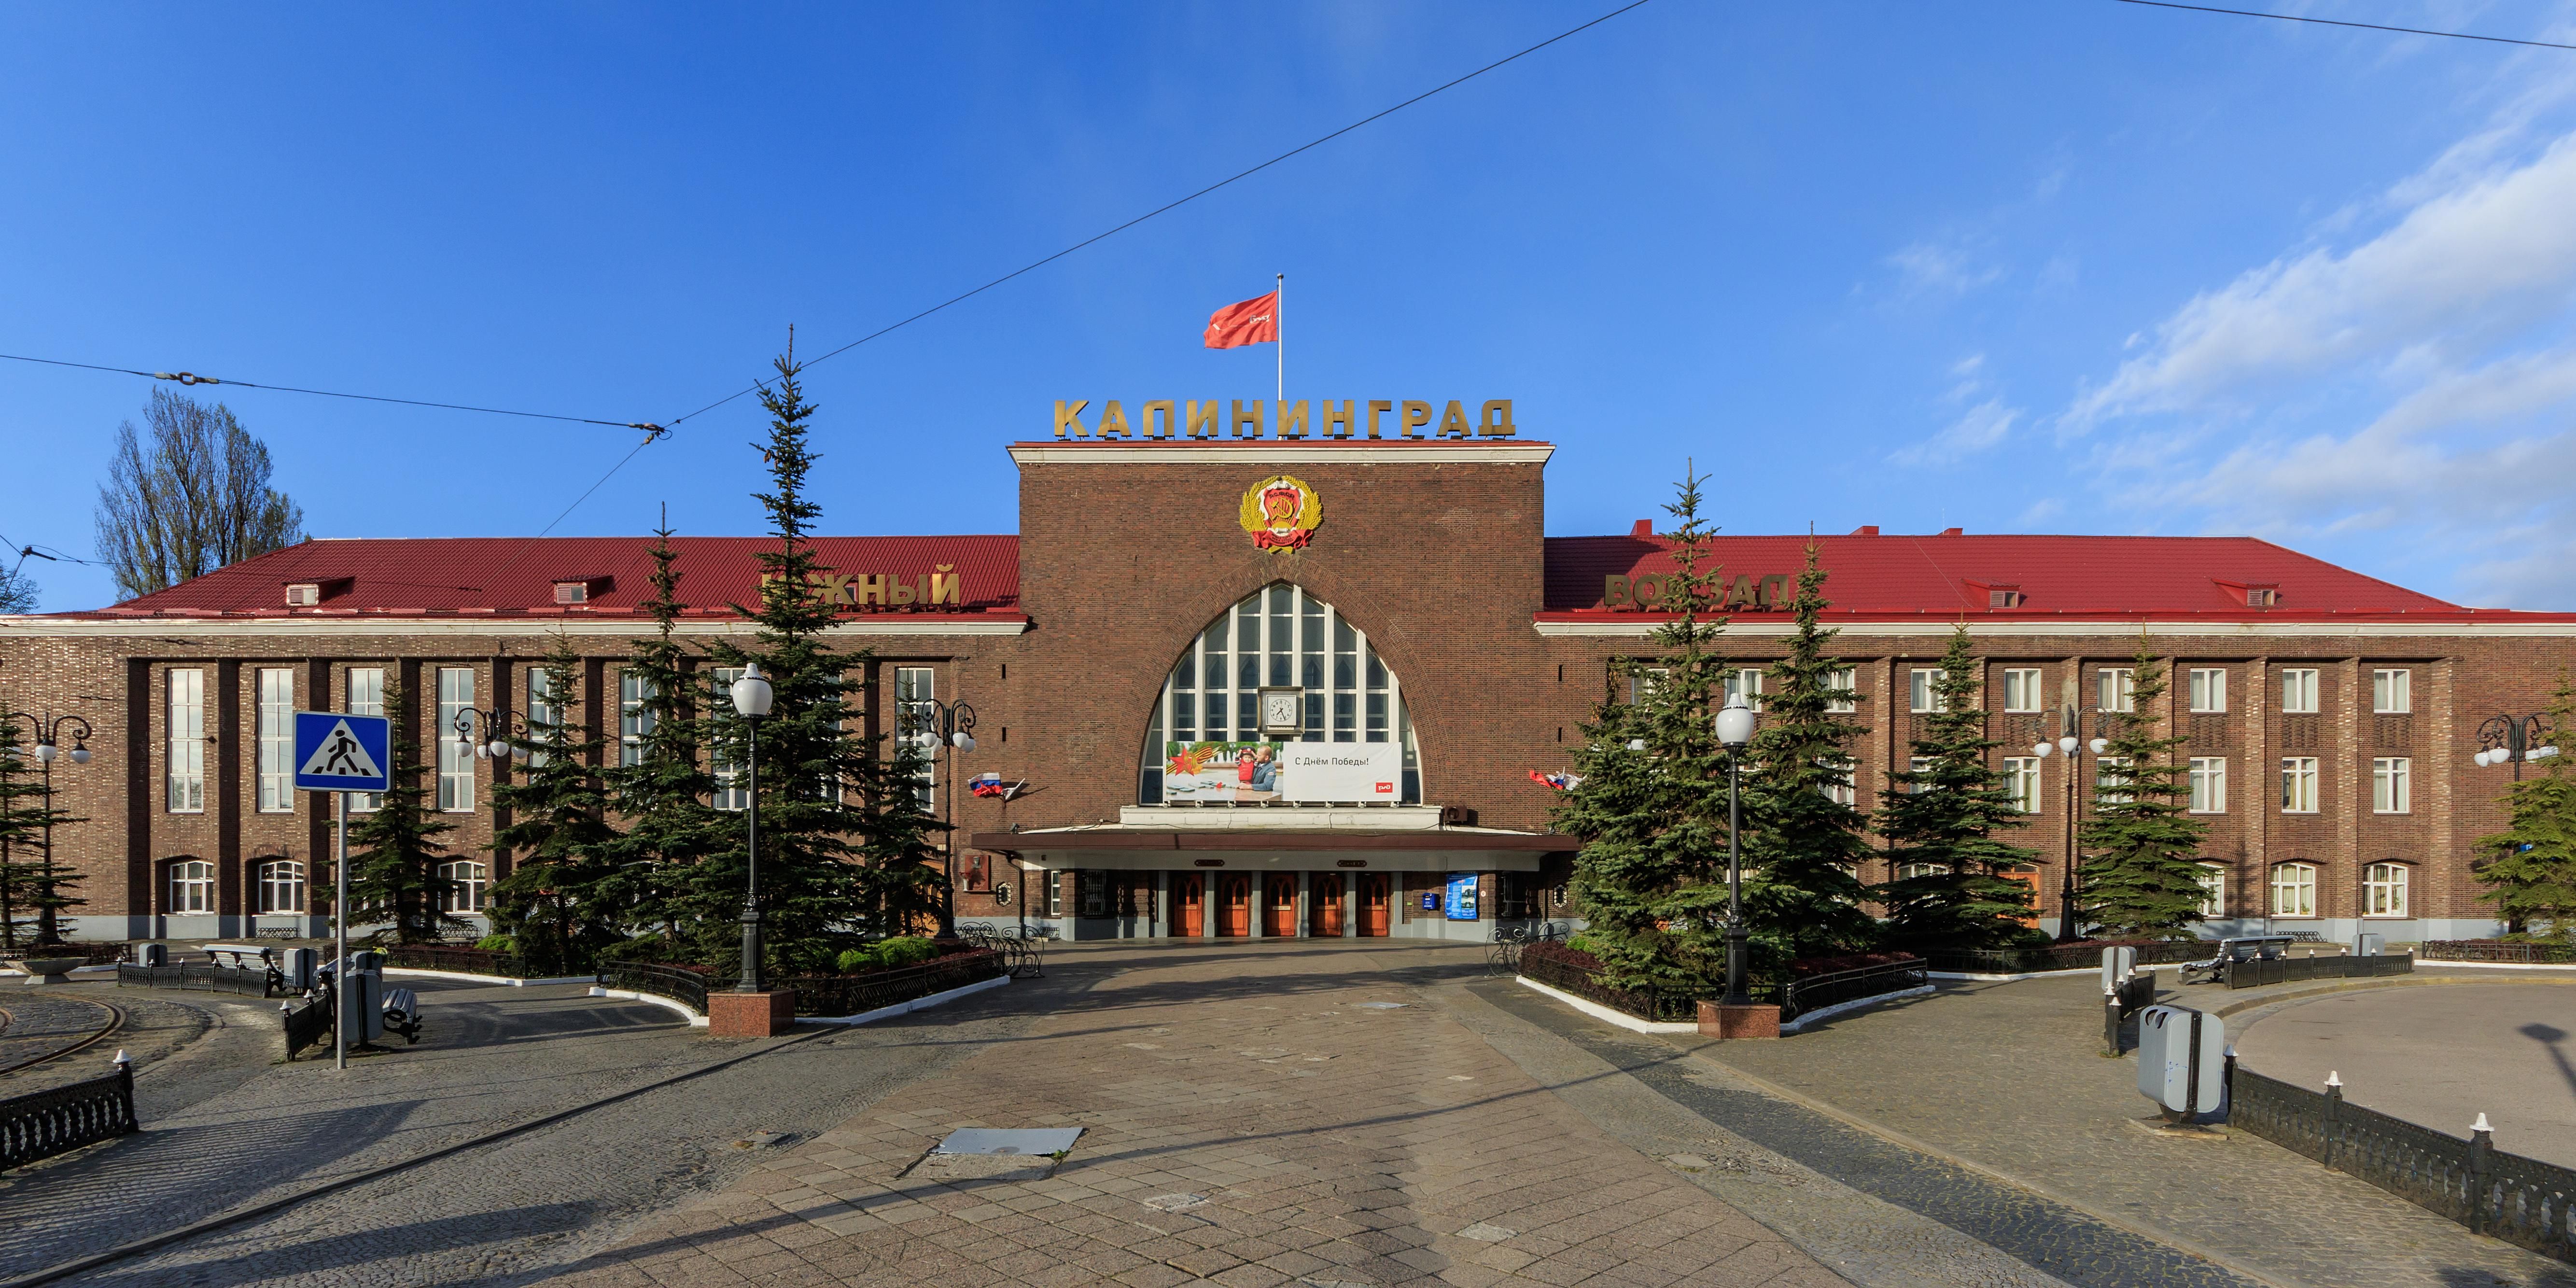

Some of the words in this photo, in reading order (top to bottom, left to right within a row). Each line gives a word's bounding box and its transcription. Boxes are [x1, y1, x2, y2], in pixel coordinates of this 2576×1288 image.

[1054, 400, 1516, 437] КАЛИНИНГРАД
[1303, 757, 1328, 766] Днём
[1332, 757, 1369, 766] Победы!
